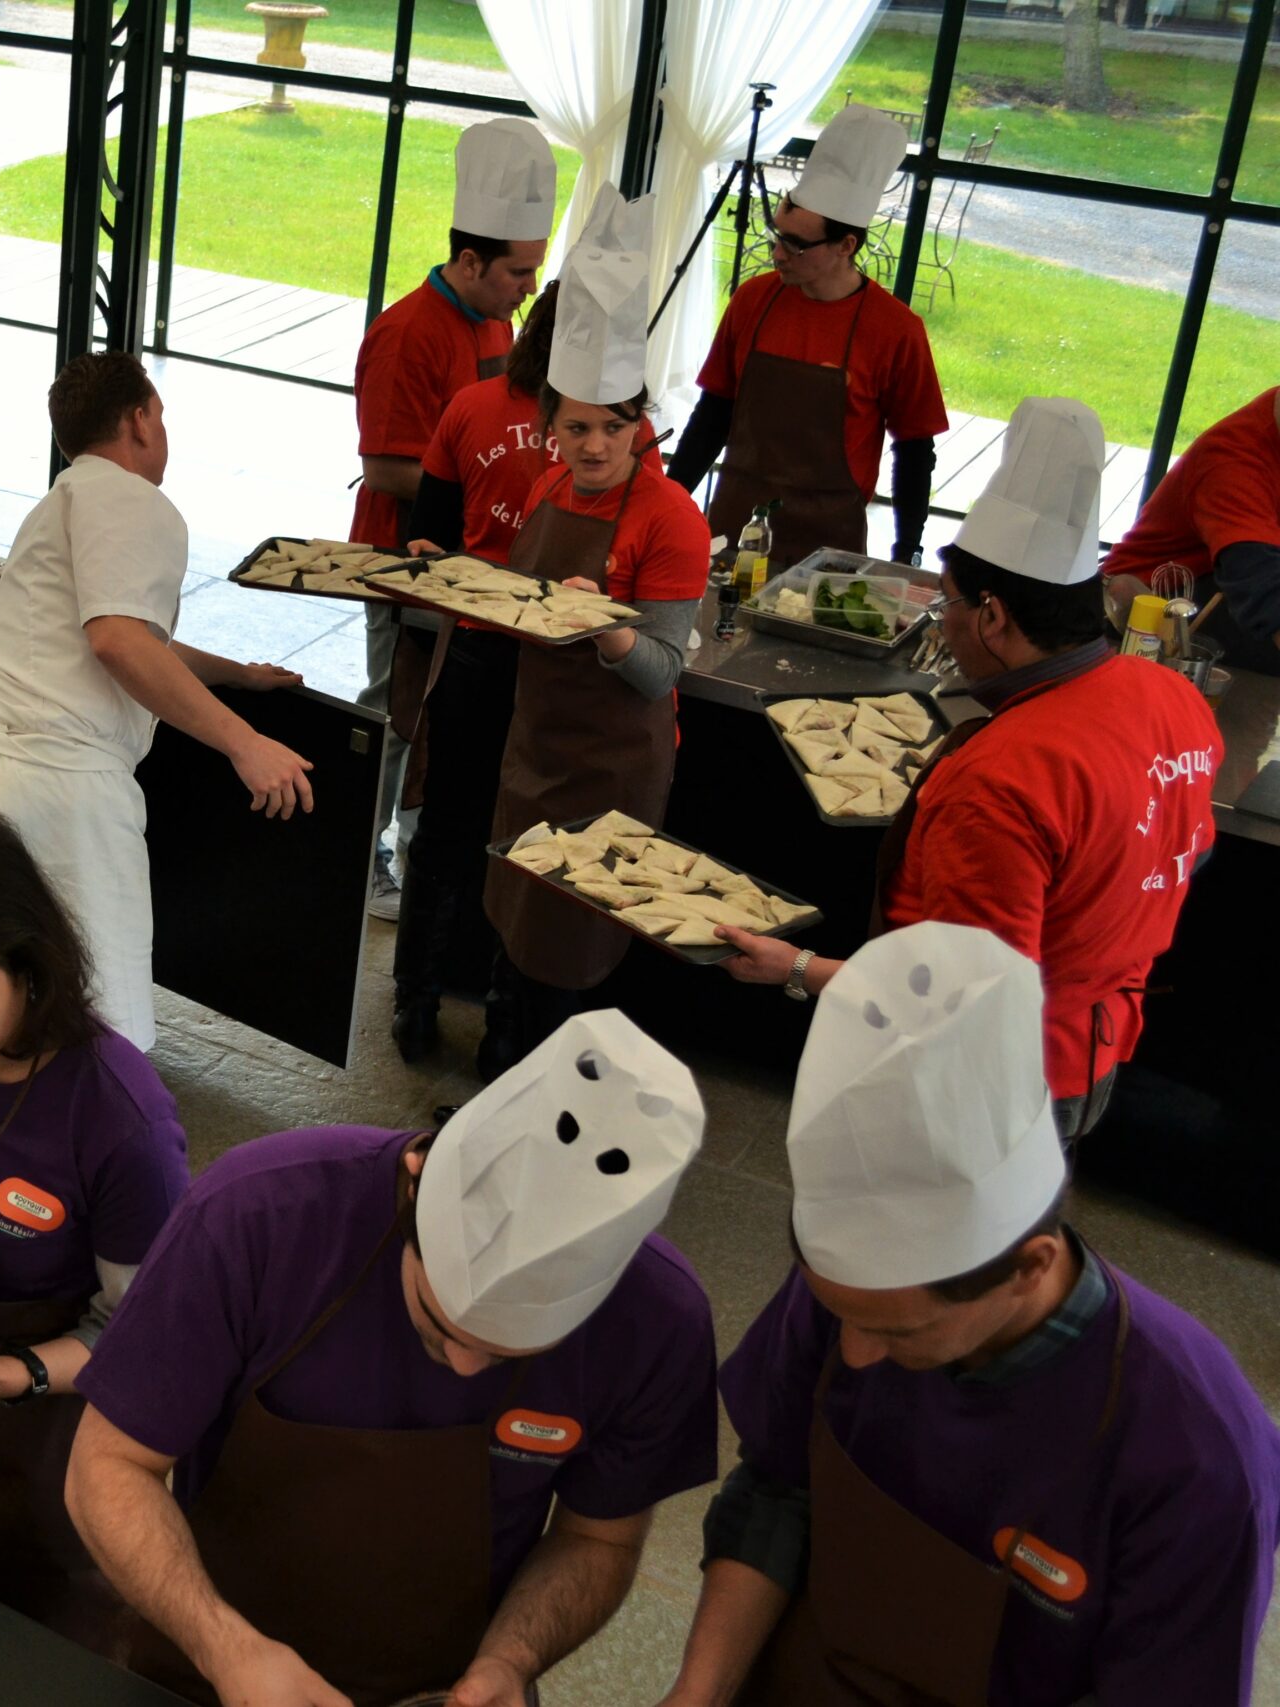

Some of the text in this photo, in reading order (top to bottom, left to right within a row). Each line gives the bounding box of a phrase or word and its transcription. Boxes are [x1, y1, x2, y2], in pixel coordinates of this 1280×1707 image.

[477, 422, 560, 469] Les Toq
[491, 502, 510, 523] de
[1135, 796, 1156, 838] Les
[14, 1193, 47, 1214] BOUYGUES
